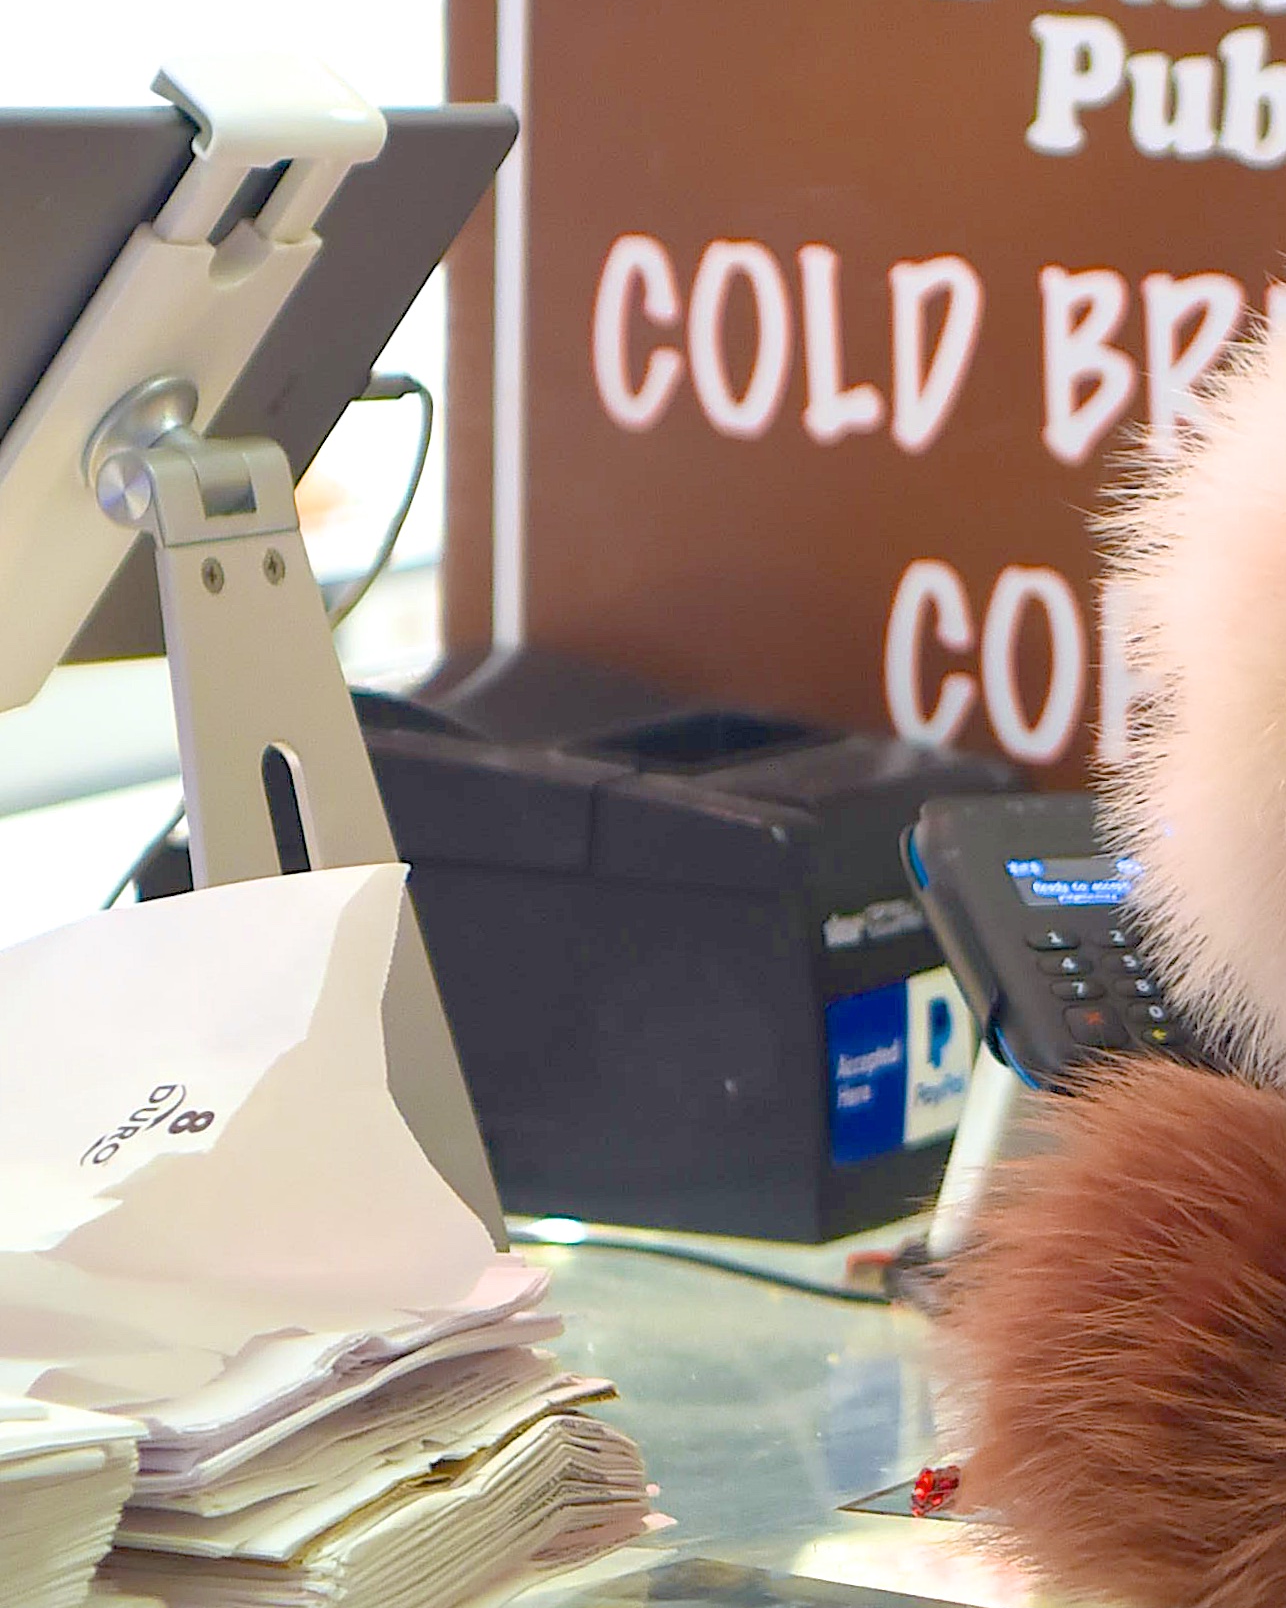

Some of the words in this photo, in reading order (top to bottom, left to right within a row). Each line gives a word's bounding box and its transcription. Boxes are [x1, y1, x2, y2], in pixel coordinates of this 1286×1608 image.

[593, 234, 984, 454] COLD
[1071, 980, 1084, 995] 7
[92, 1084, 178, 1165] DURO
[168, 1110, 215, 1134] 8
